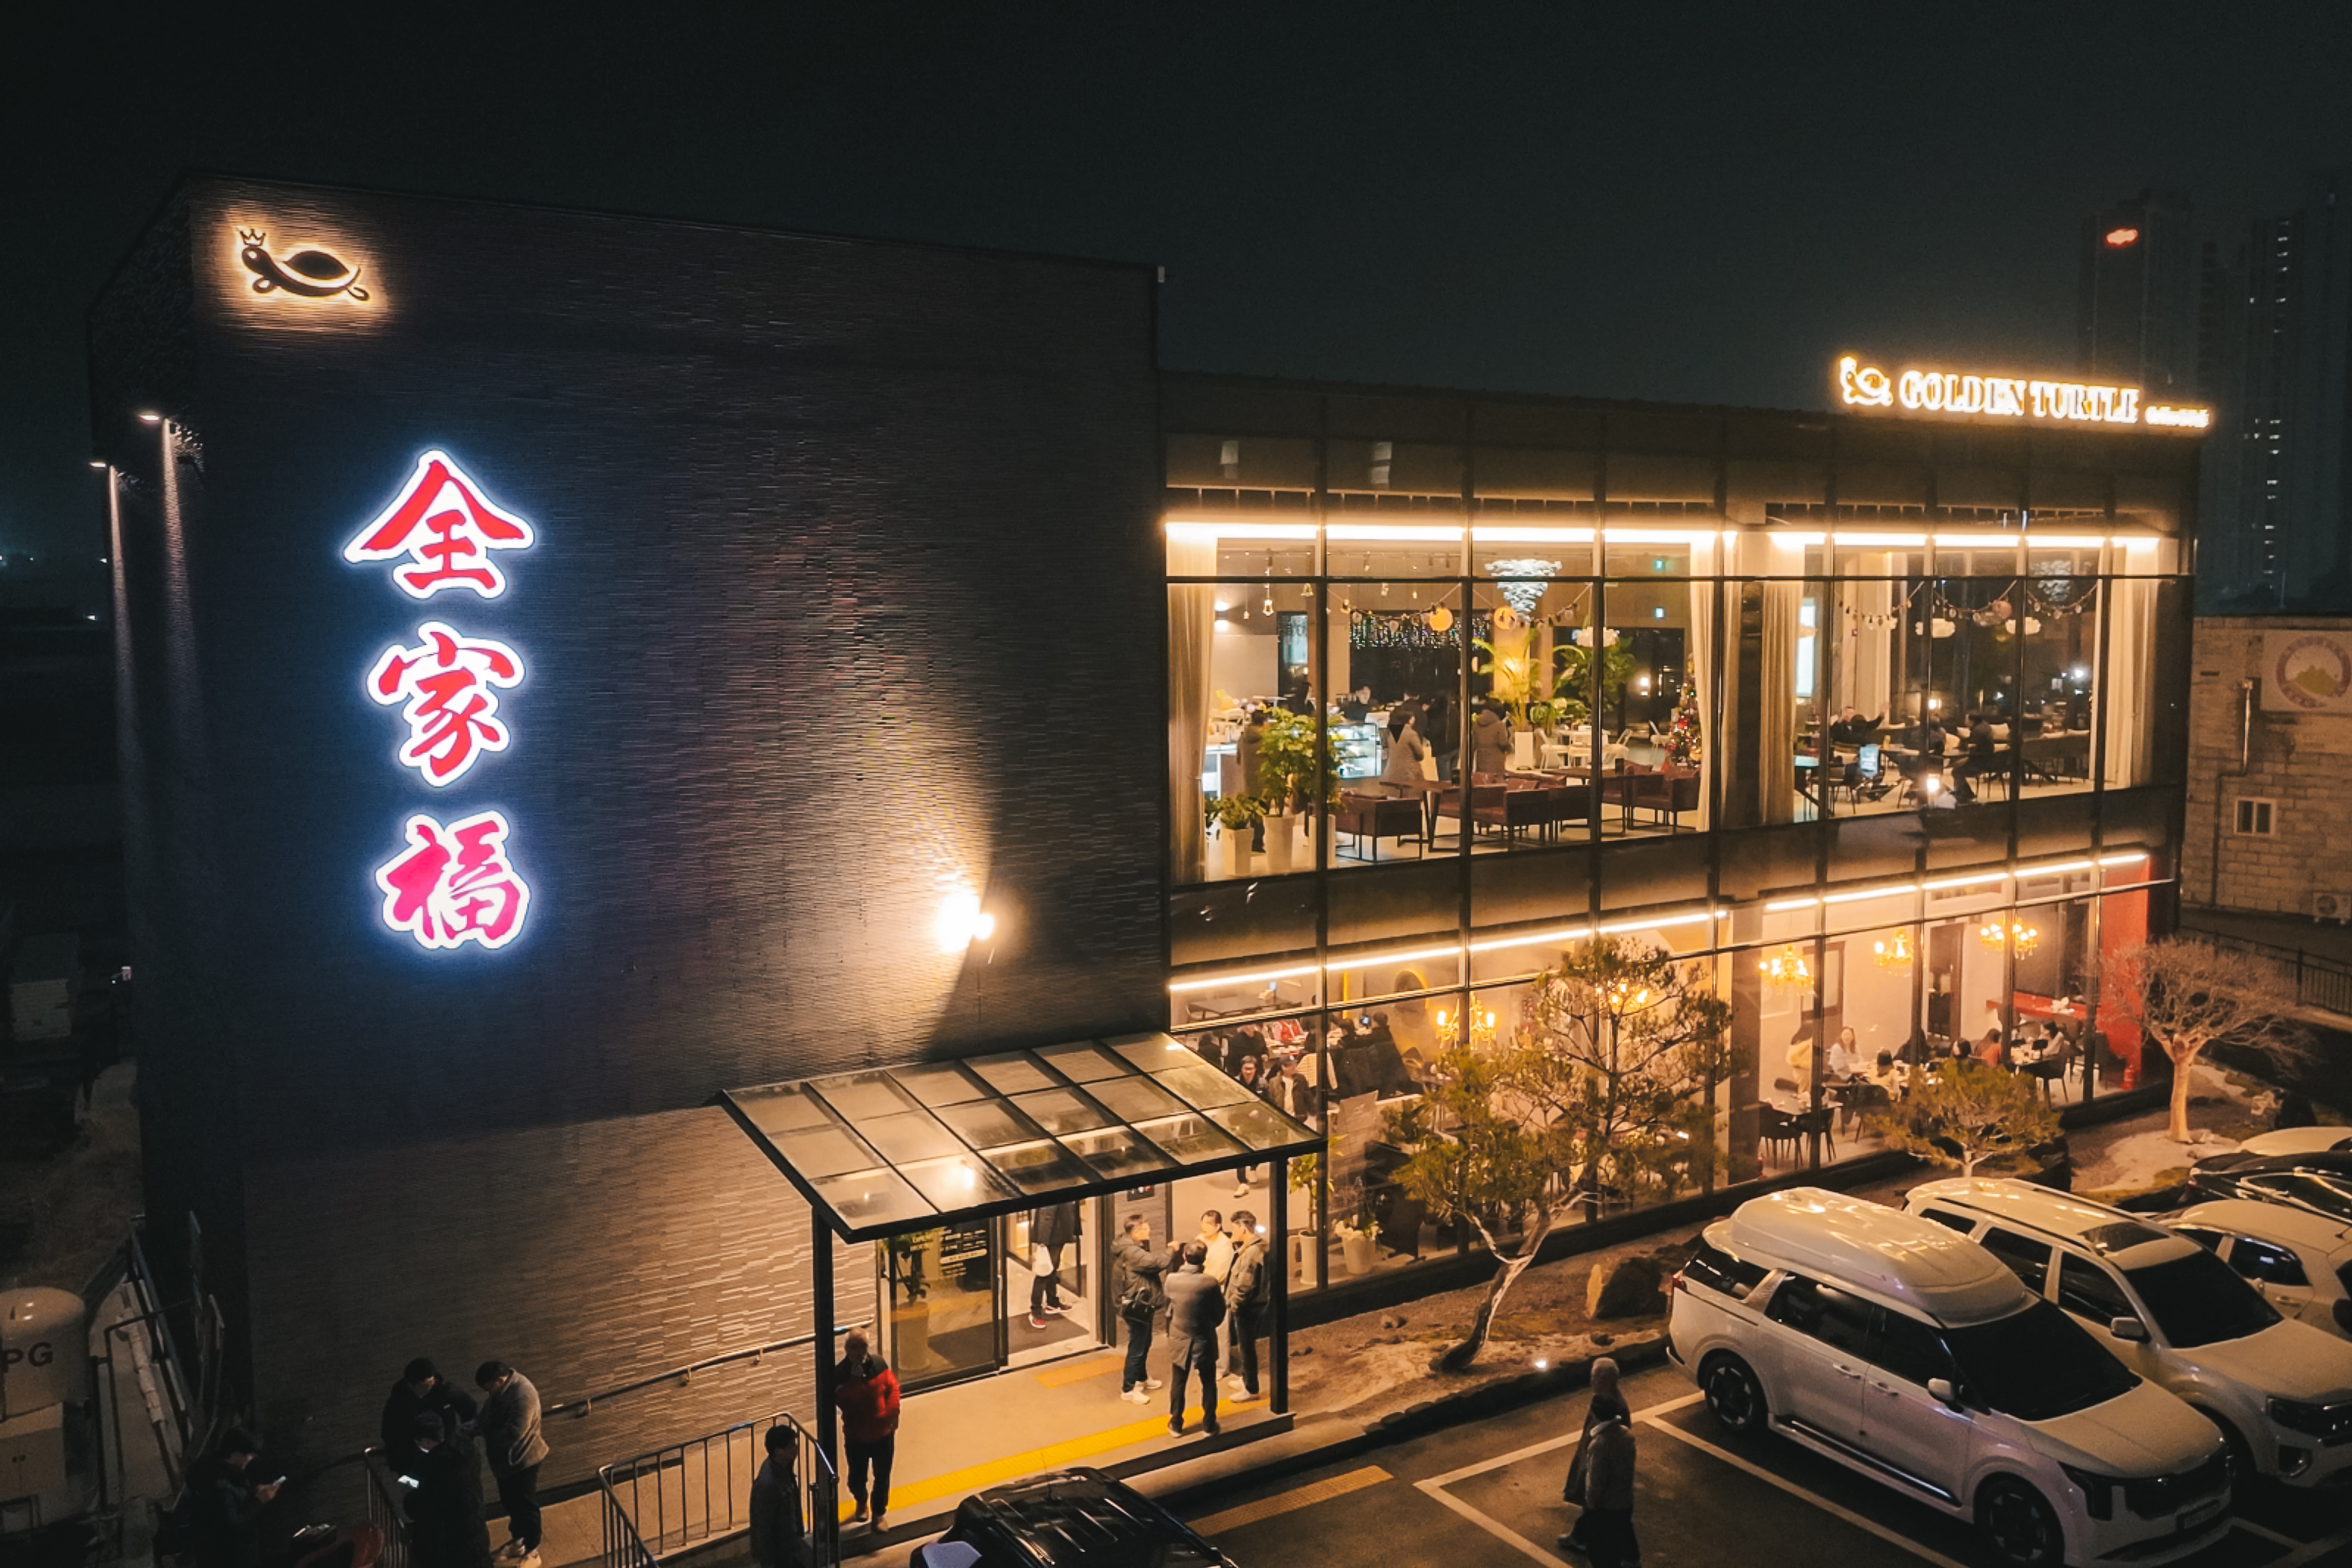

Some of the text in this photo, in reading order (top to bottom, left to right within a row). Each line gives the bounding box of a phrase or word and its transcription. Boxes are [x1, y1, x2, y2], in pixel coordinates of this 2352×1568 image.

[1899, 370, 2027, 415] GOLDEN
[2030, 381, 2138, 422] TURTLE
[346, 450, 533, 948] 全家福
